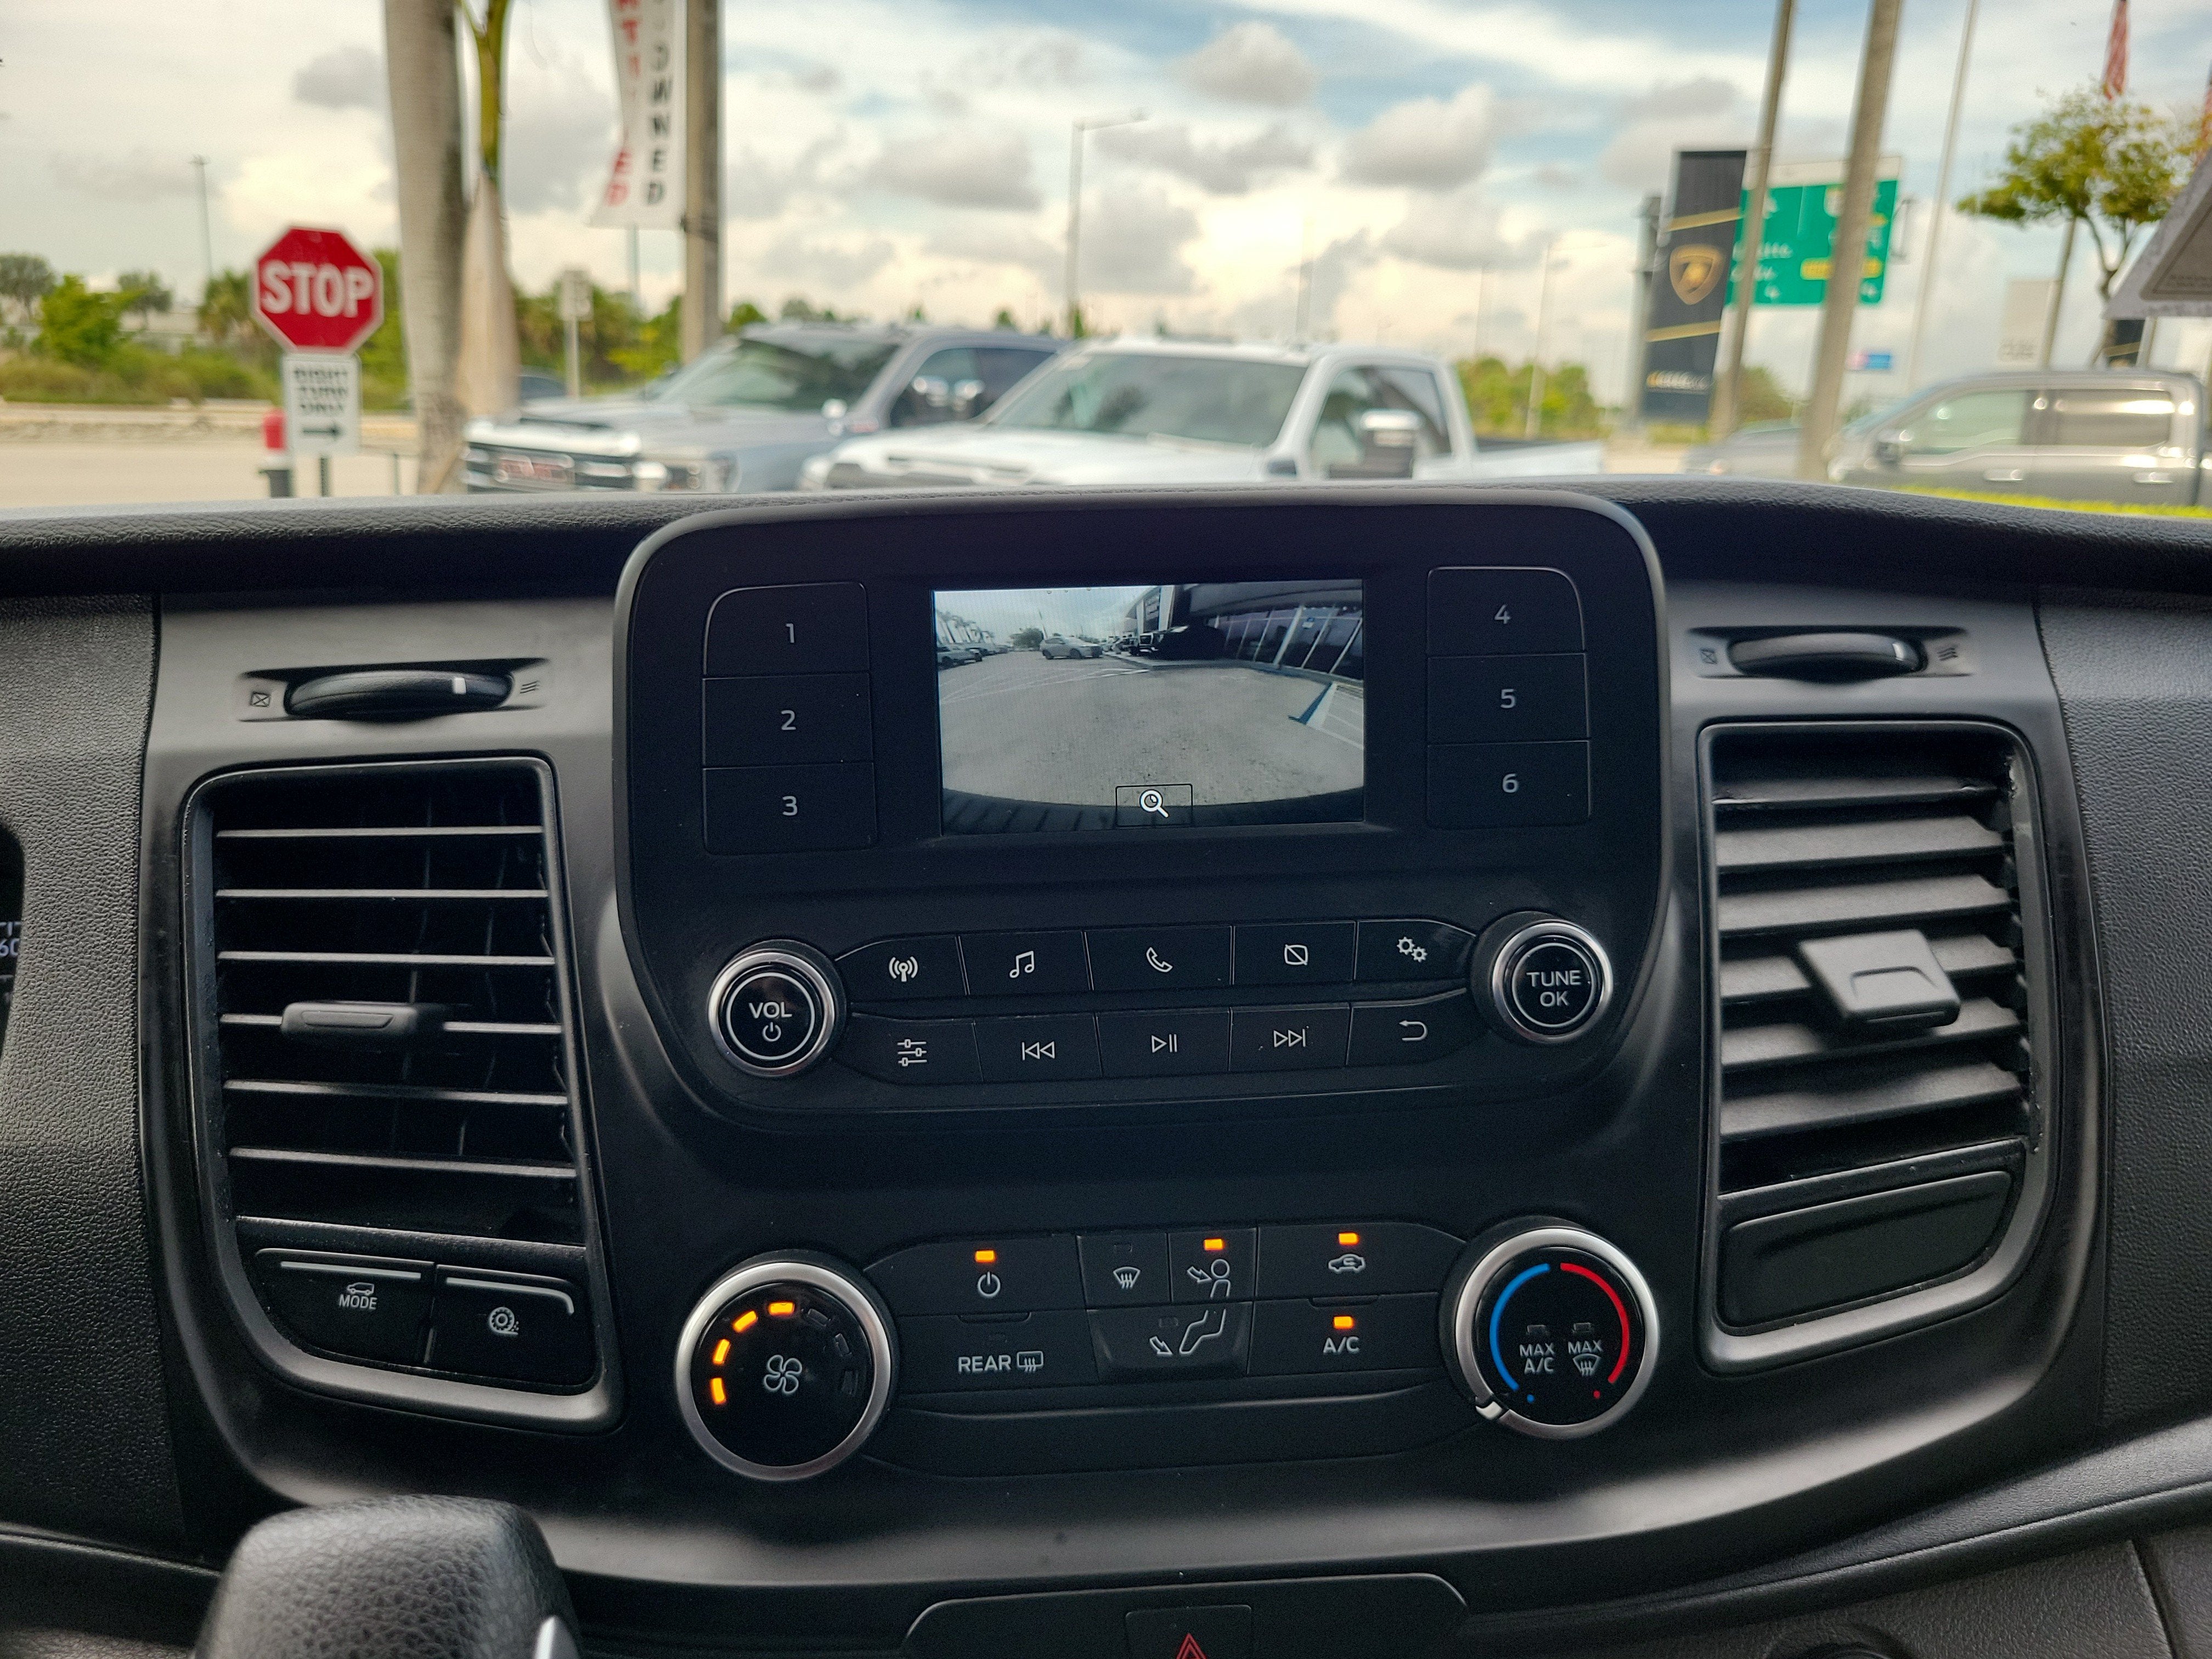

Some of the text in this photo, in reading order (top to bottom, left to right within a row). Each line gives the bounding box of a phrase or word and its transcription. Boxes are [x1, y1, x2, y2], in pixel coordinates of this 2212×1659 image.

[261, 260, 374, 317] STOP
[1494, 605, 1511, 624] 4
[786, 623, 795, 644] 1
[1500, 689, 1516, 709] 5
[781, 710, 797, 731] 2
[1502, 773, 1519, 793] 6
[782, 795, 798, 816] 3
[1527, 969, 1581, 987] TUNE
[1540, 991, 1570, 1008] OK
[748, 1001, 793, 1019] VOL
[338, 1294, 377, 1311] MODE
[1323, 1336, 1359, 1354] A/C
[1519, 1343, 1555, 1356] MAX
[1567, 1340, 1602, 1354] MAX
[958, 1355, 1012, 1373] REAR
[1523, 1357, 1554, 1374] A/C
